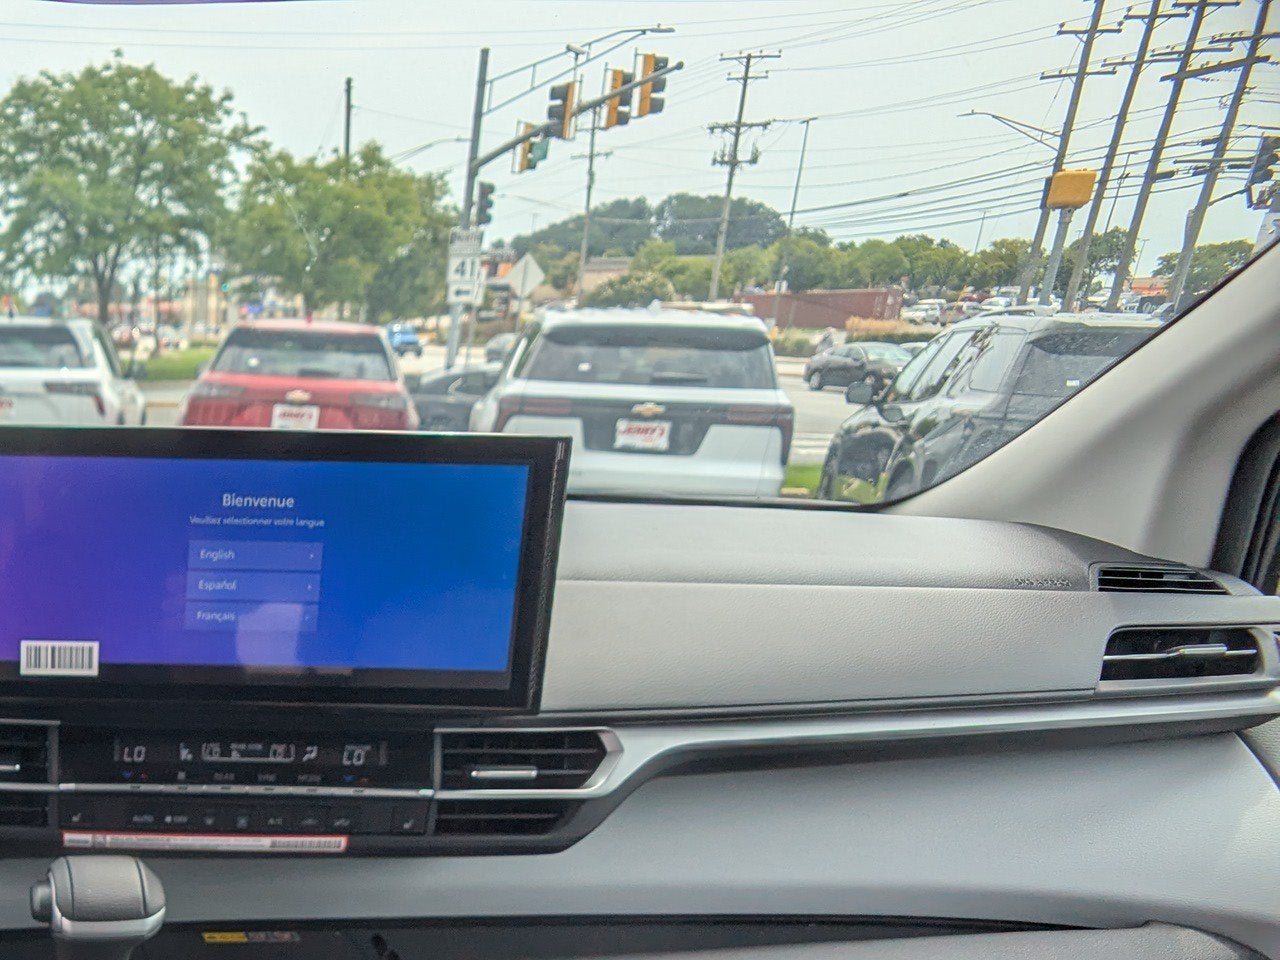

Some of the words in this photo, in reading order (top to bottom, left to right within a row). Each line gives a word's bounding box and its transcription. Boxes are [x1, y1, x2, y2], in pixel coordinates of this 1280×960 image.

[223, 493, 295, 508] Bienvenue
[296, 518, 325, 529] langue
[200, 550, 235, 561] English
[198, 580, 236, 591] Español
[196, 611, 236, 623] Français
